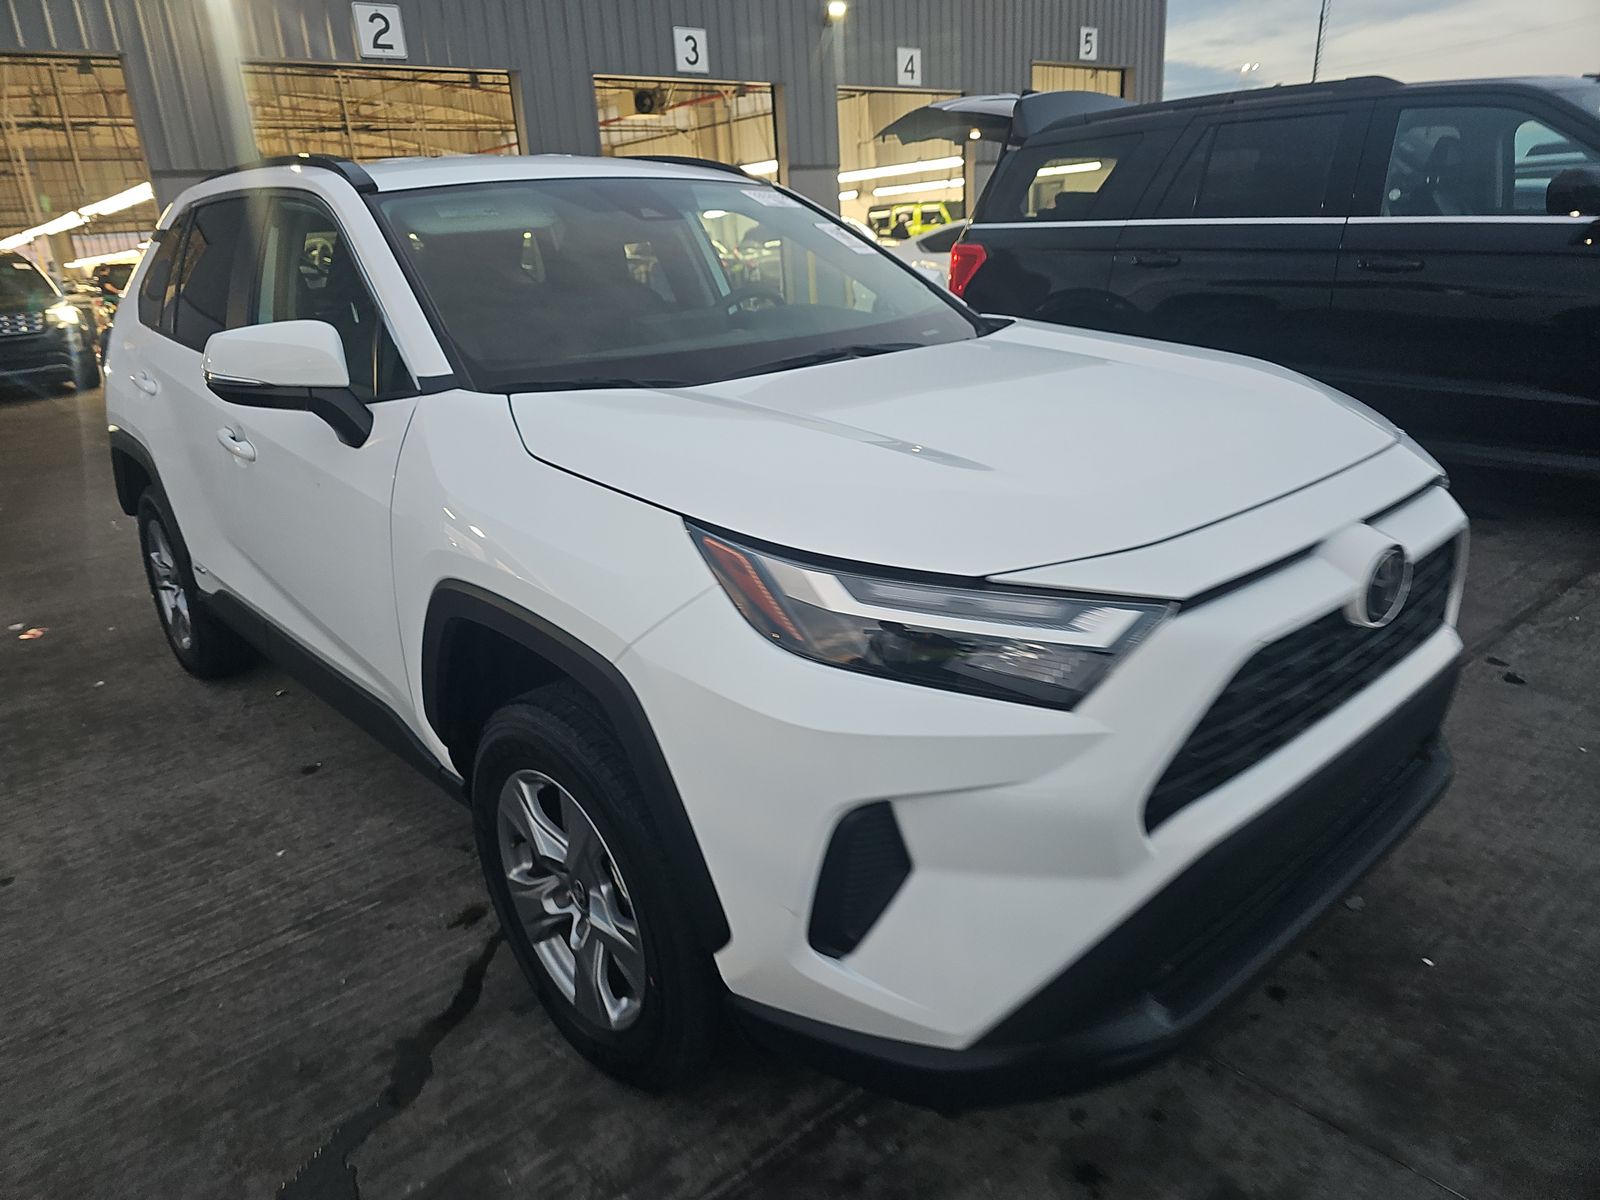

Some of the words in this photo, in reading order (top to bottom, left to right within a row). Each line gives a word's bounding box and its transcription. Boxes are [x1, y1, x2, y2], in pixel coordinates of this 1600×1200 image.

[368, 12, 394, 50] 2
[1084, 32, 1093, 56] 5
[684, 34, 700, 66] 3
[904, 54, 916, 80] 4
